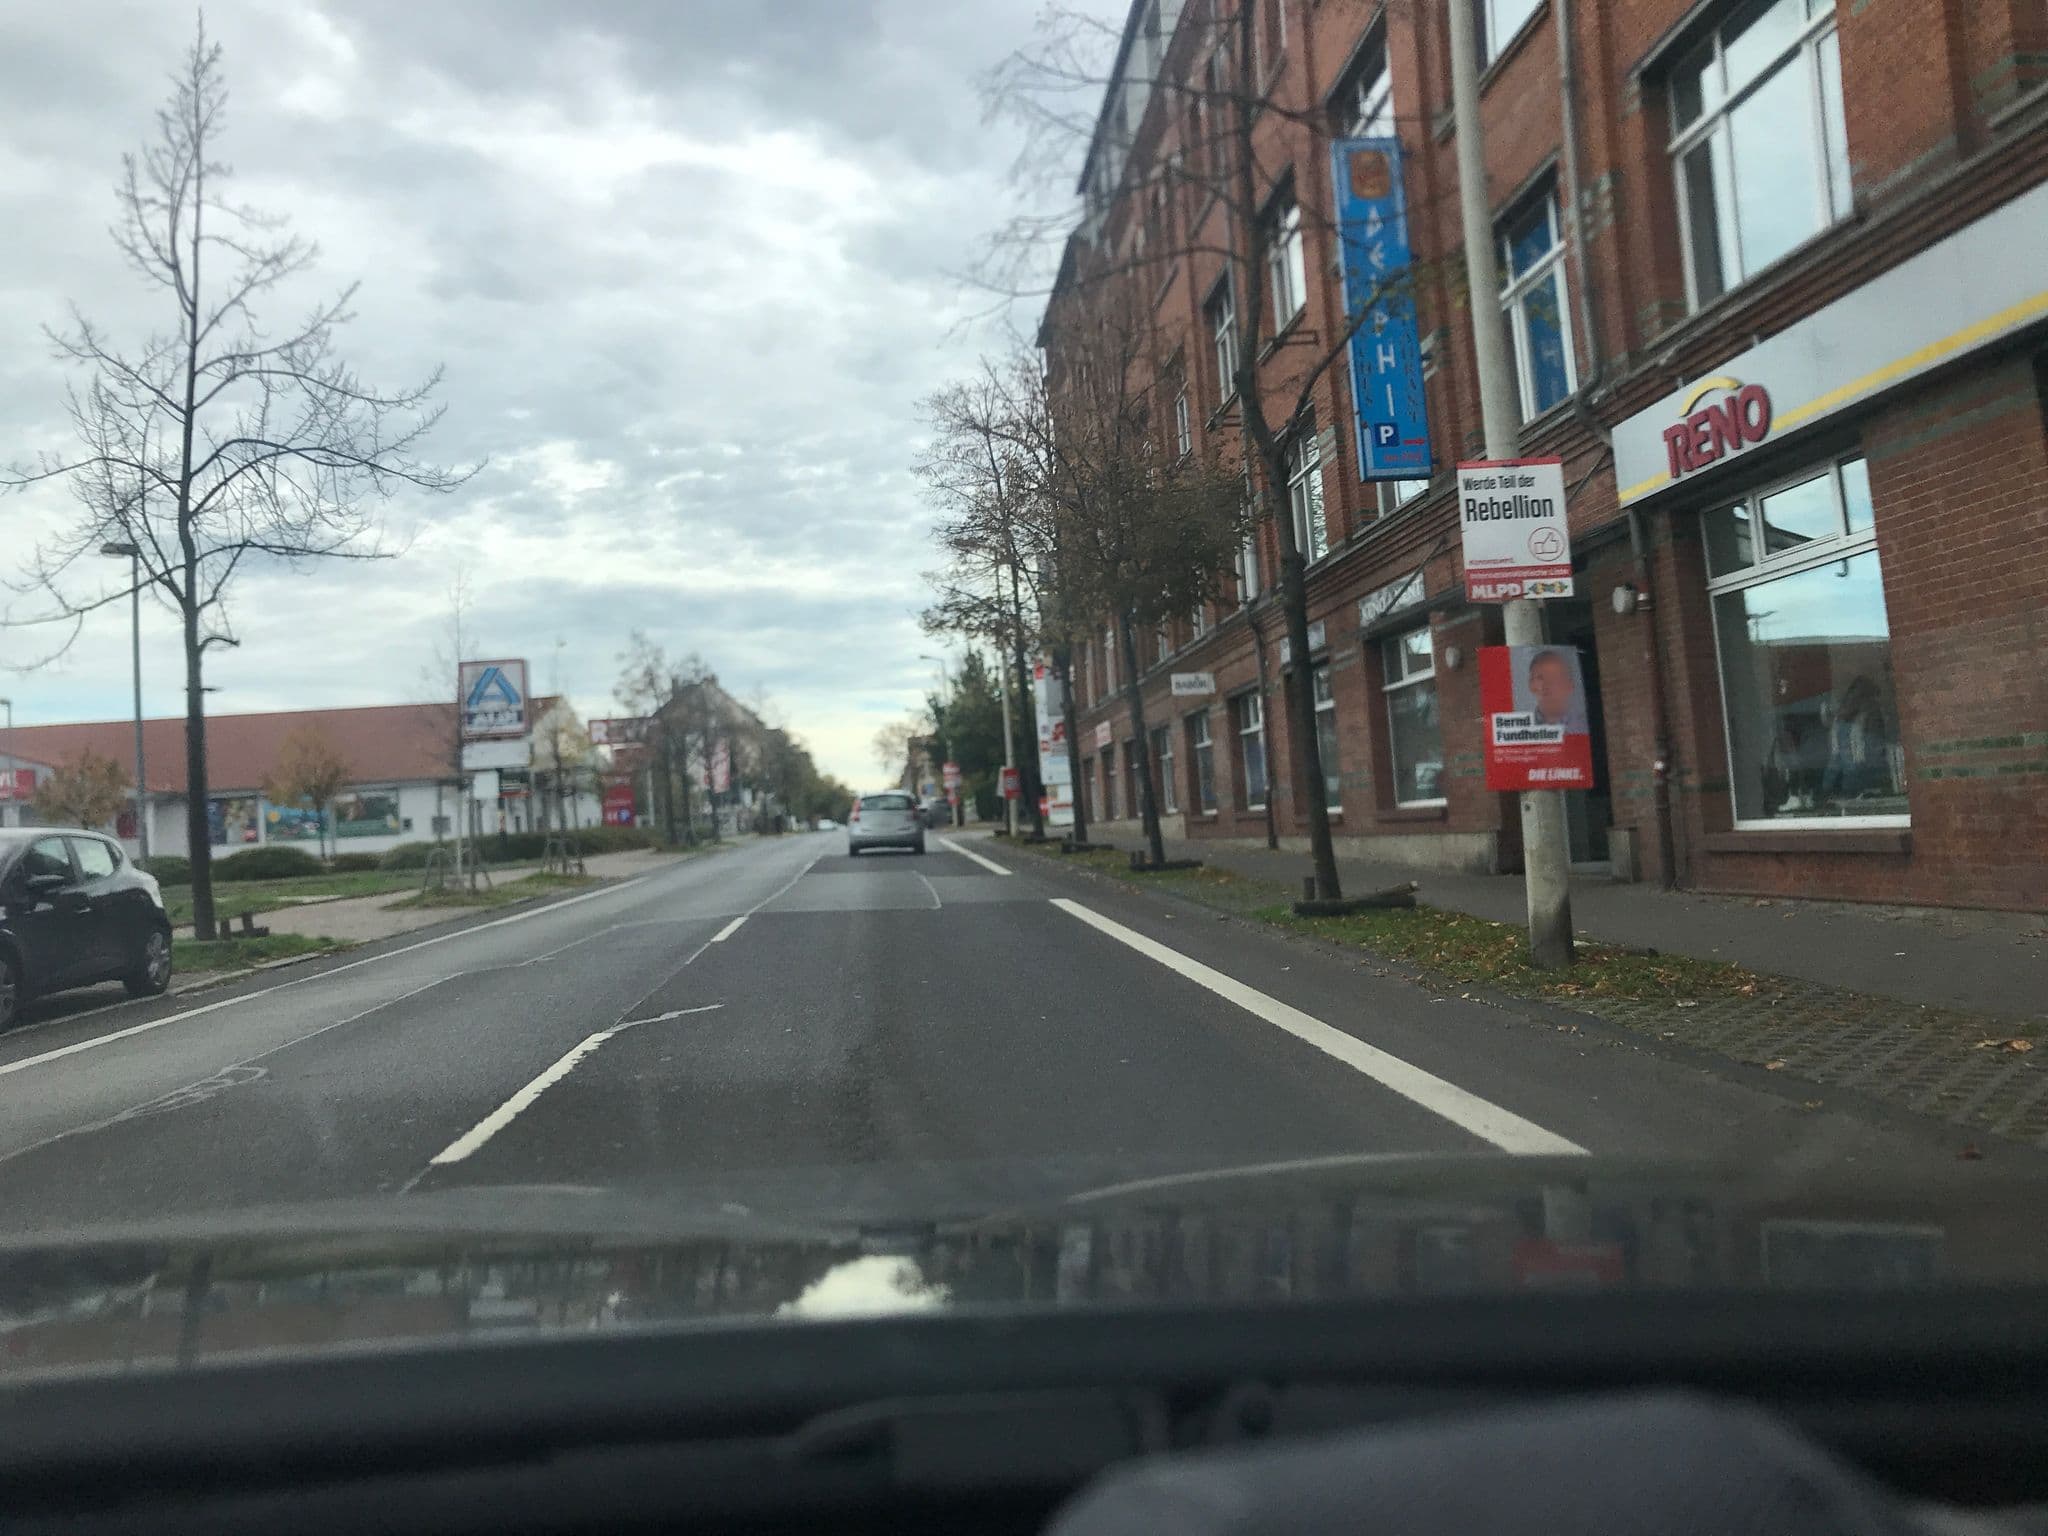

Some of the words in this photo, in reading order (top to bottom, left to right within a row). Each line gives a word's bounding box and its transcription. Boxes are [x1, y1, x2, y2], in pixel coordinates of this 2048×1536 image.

[1379, 424, 1396, 445] P
[1663, 384, 1771, 478] RENO
[1463, 475, 1497, 491] Werde
[1499, 474, 1517, 488] Teil
[1518, 474, 1536, 487] der
[1466, 494, 1554, 522] Rebellion
[1472, 583, 1521, 599] MLPD
